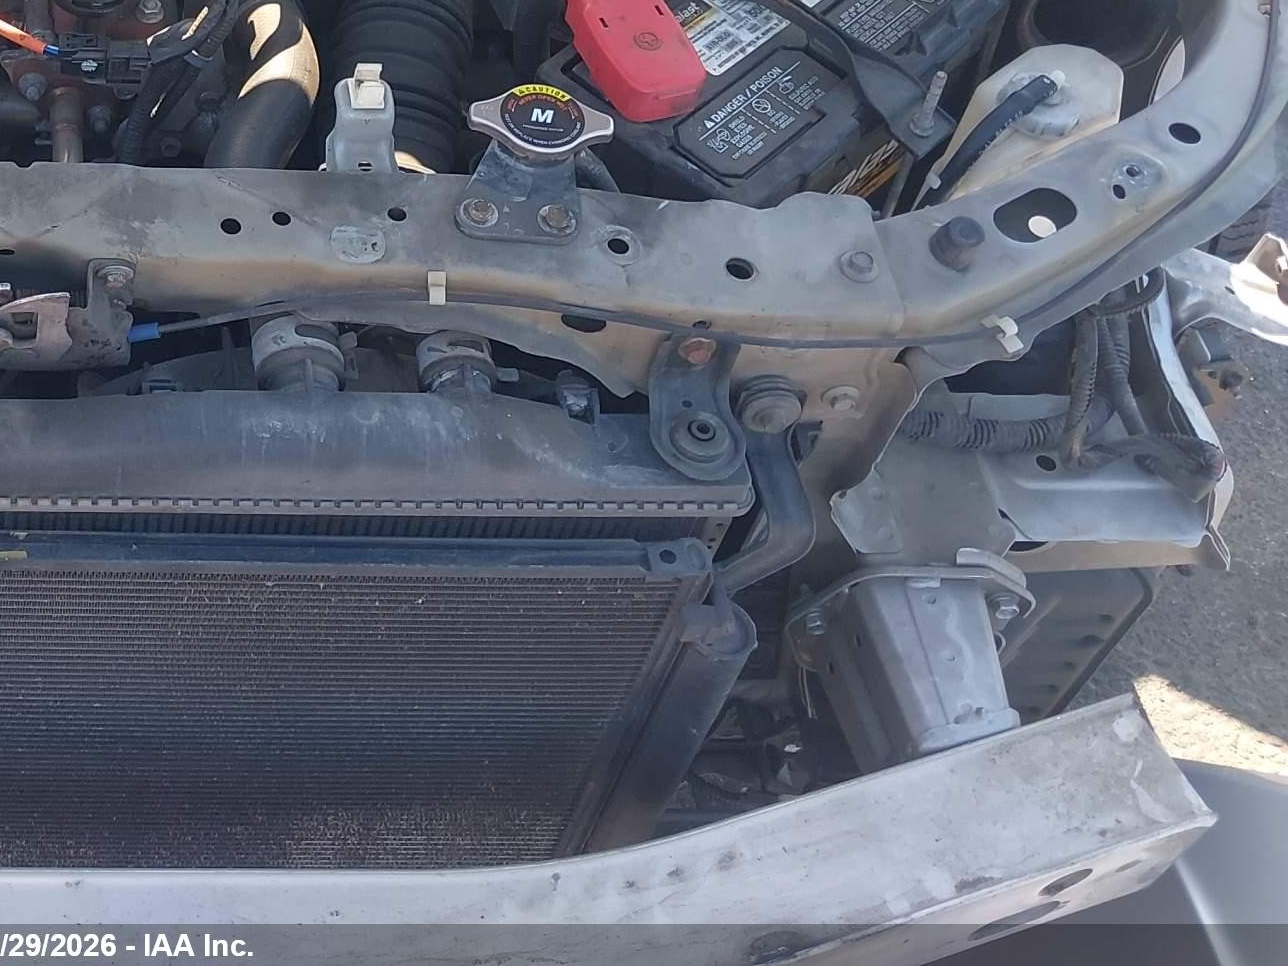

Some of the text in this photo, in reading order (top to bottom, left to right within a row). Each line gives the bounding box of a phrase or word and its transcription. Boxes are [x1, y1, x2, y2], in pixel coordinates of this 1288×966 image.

[524, 86, 567, 100] CAUTION
[711, 94, 747, 123] DANGER
[749, 66, 783, 92] POISON
[530, 108, 555, 124] M
